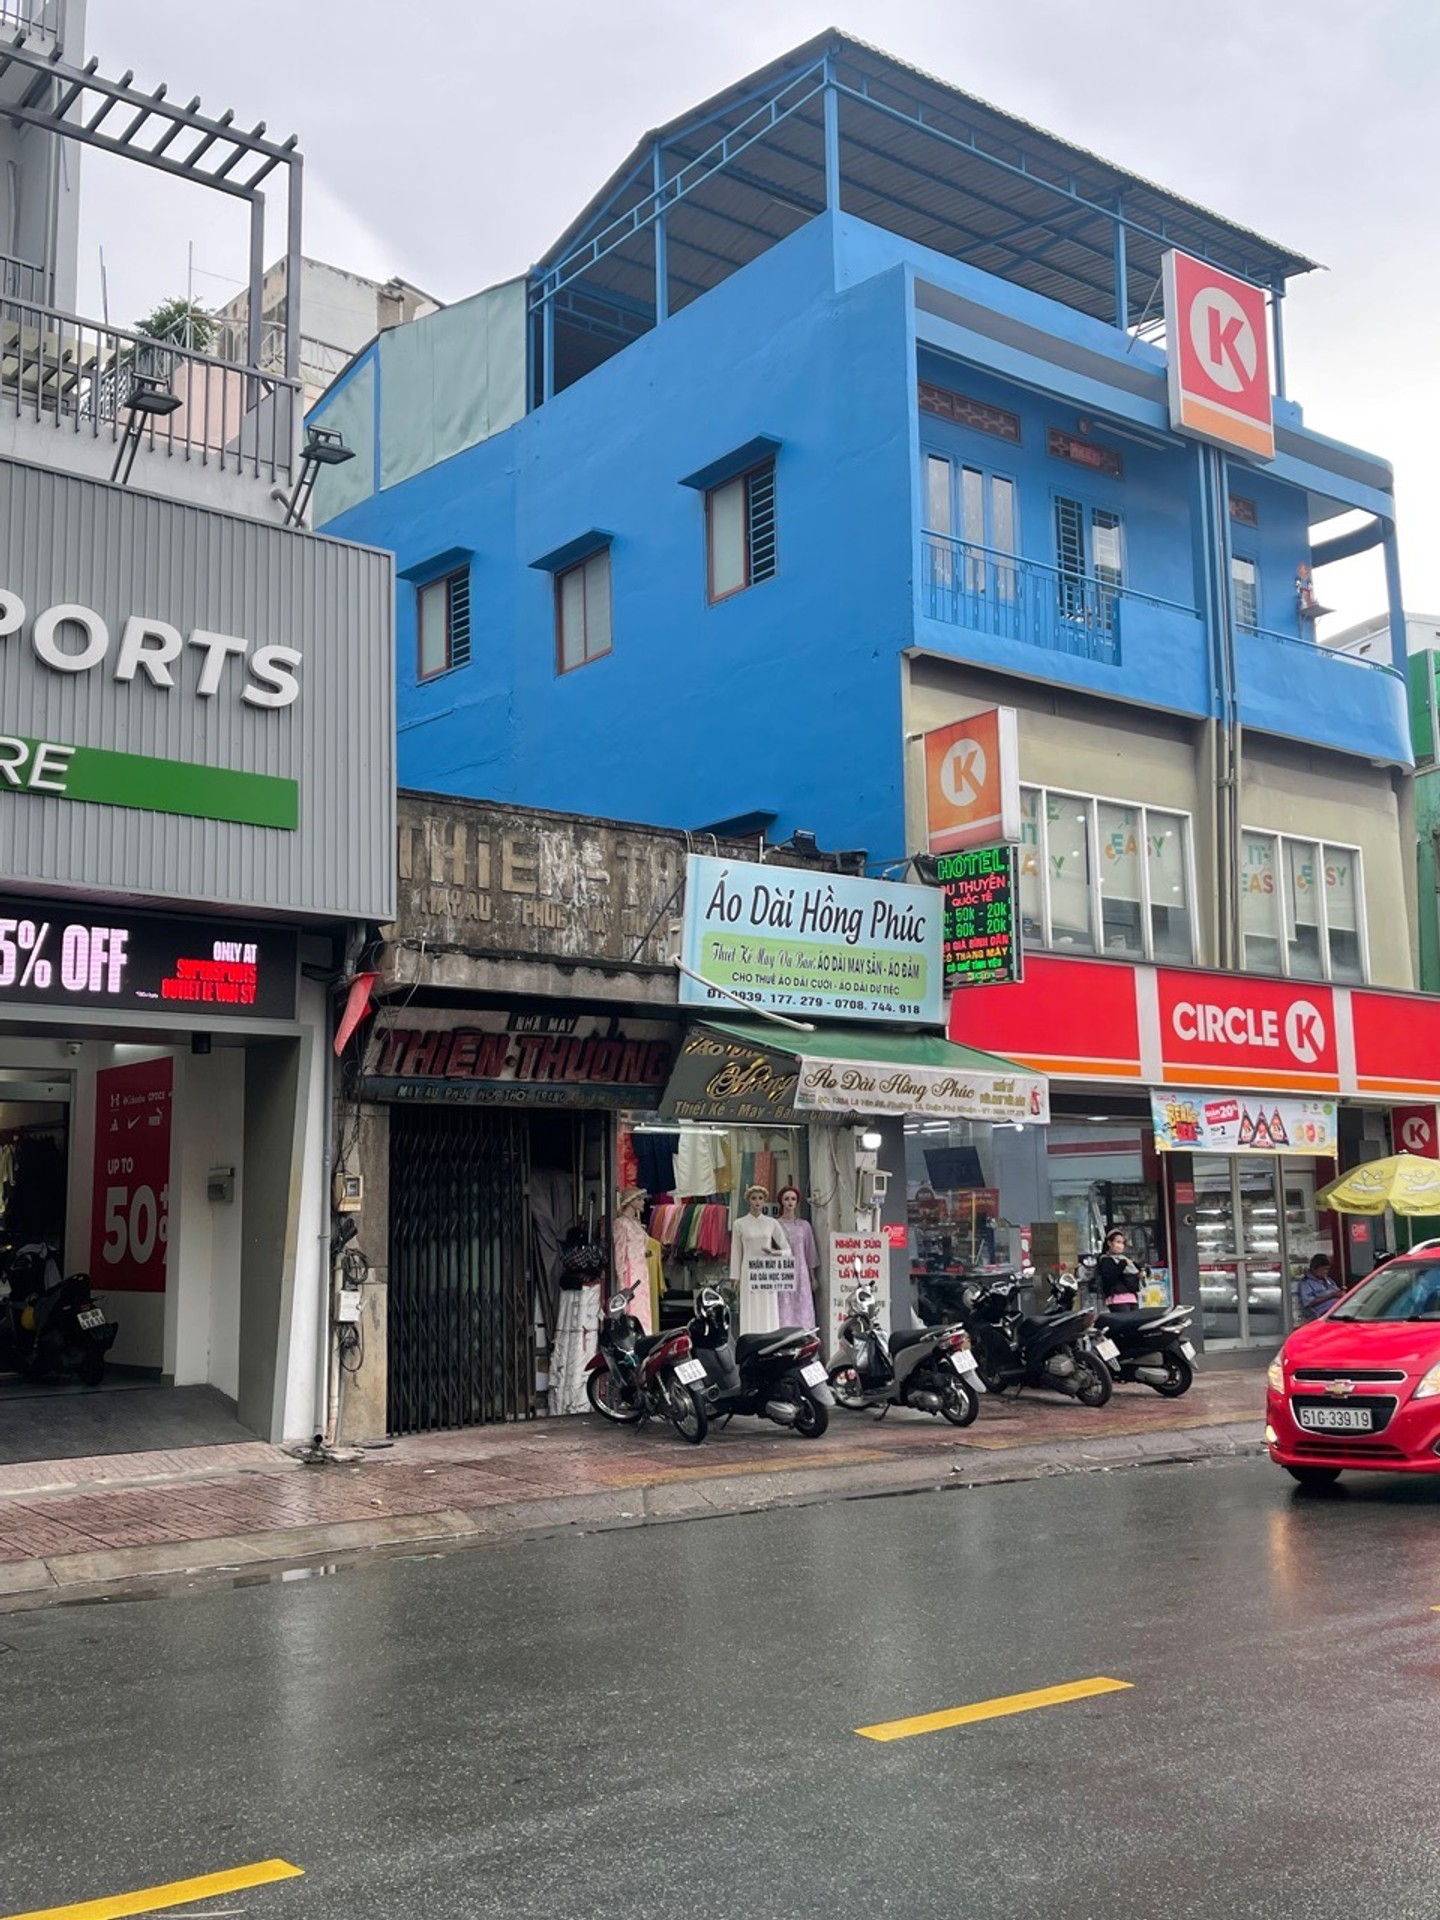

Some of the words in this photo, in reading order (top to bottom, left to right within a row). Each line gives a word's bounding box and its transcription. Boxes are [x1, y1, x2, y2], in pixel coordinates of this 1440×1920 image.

[1205, 303, 1255, 392] K
[951, 747, 985, 800] K
[937, 848, 1006, 880] HOTEL
[705, 869, 742, 922] Áo
[750, 884, 795, 928] Dài
[799, 885, 864, 945] Hồng
[869, 900, 926, 944] Phúc
[955, 907, 975, 922] 50k
[987, 902, 1007, 918] 20k
[987, 918, 1007, 934] 20k
[61, 924, 129, 994] OFF
[213, 940, 243, 963] ONLY
[243, 943, 258, 965] AT
[847, 956, 865, 974] MAY
[731, 971, 753, 983] CHO
[771, 993, 797, 1006] 177.
[799, 996, 823, 1007] 279
[835, 998, 868, 1011] 0708.
[872, 1001, 897, 1013] 744.
[899, 1003, 921, 1015] 918
[1172, 1001, 1280, 1048] CIRCLE
[1293, 1012, 1323, 1060] K
[841, 1071, 876, 1092] Dài
[879, 1072, 928, 1103] Hồng
[931, 1076, 975, 1099] Phúc
[737, 1103, 766, 1119] May
[1407, 1121, 1430, 1148] K
[107, 1158, 119, 1175] UP
[121, 1157, 133, 1174] TO
[781, 1272, 794, 1281] SINH
[1301, 1409, 1370, 1428] 51G-339.19
